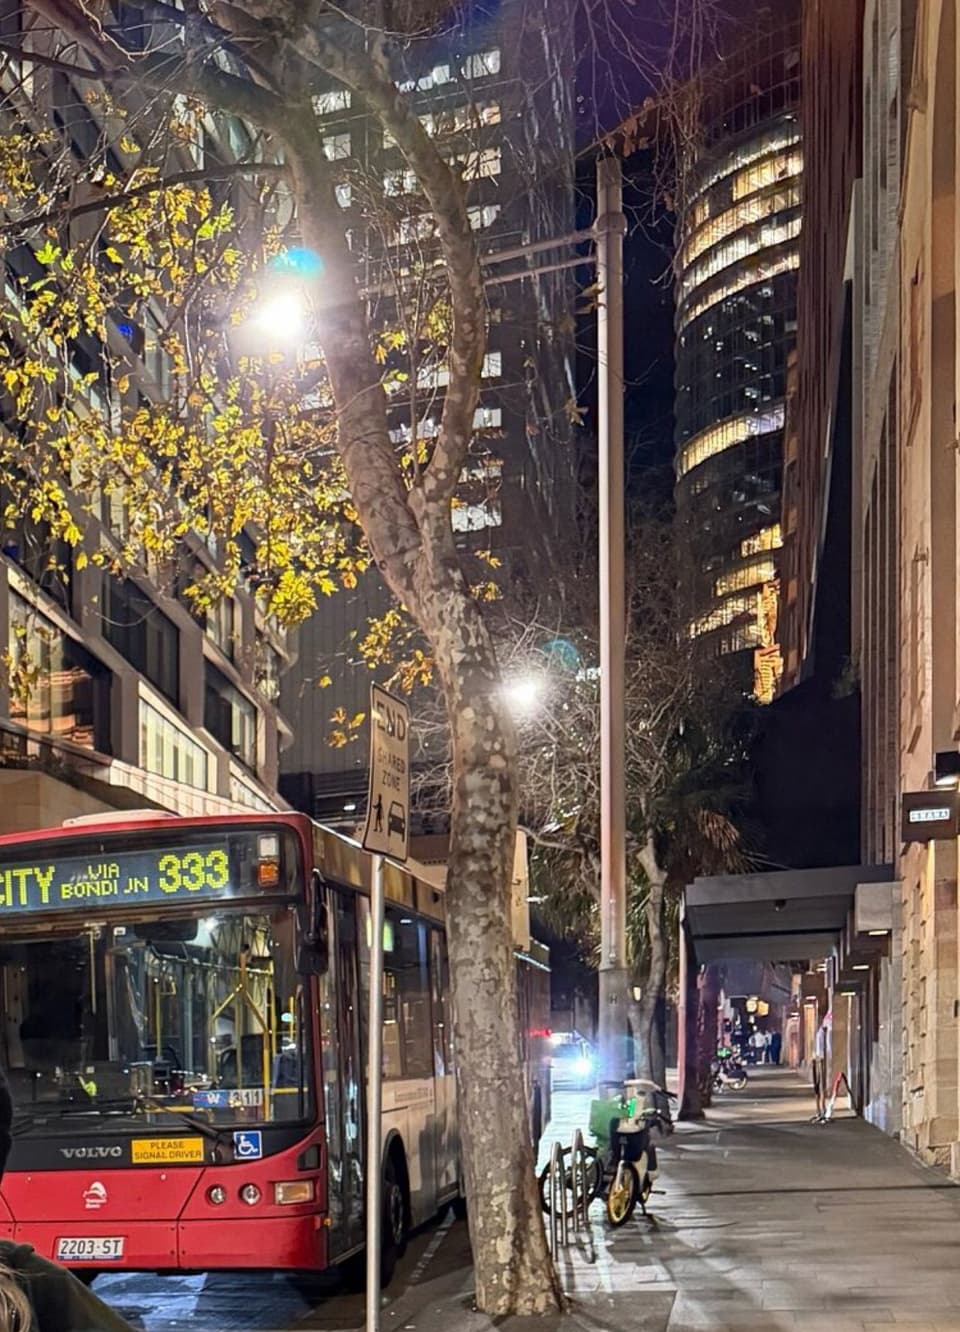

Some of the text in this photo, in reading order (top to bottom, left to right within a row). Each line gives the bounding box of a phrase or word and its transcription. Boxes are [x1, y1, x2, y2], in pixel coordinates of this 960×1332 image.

[376, 702, 406, 741] END
[378, 748, 405, 775] SHARED
[382, 770, 401, 792] ZONE
[88, 863, 120, 881] VIA
[158, 849, 230, 893] 333
[61, 877, 149, 899] BONDI JN
[60, 1146, 122, 1159] VOLVO
[135, 1150, 202, 1160] SIGNAL DRIVER
[150, 1141, 184, 1149] PLEASE
